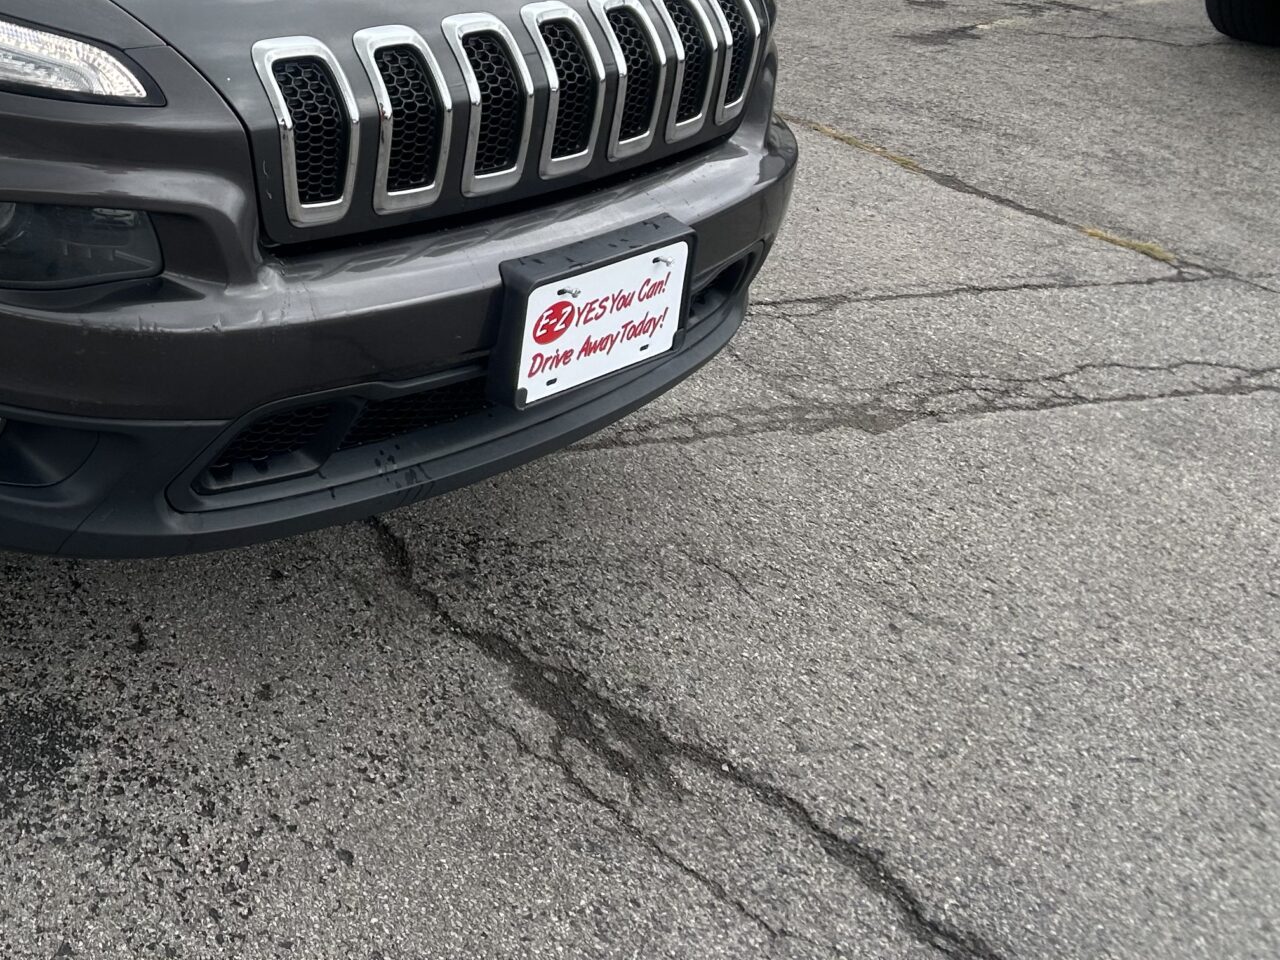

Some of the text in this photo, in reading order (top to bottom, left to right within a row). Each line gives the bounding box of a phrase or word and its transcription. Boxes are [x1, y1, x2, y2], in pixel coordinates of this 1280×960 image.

[535, 306, 573, 338] E-Z
[637, 271, 671, 303] Can!
[527, 307, 669, 378] Drive Away Today!
